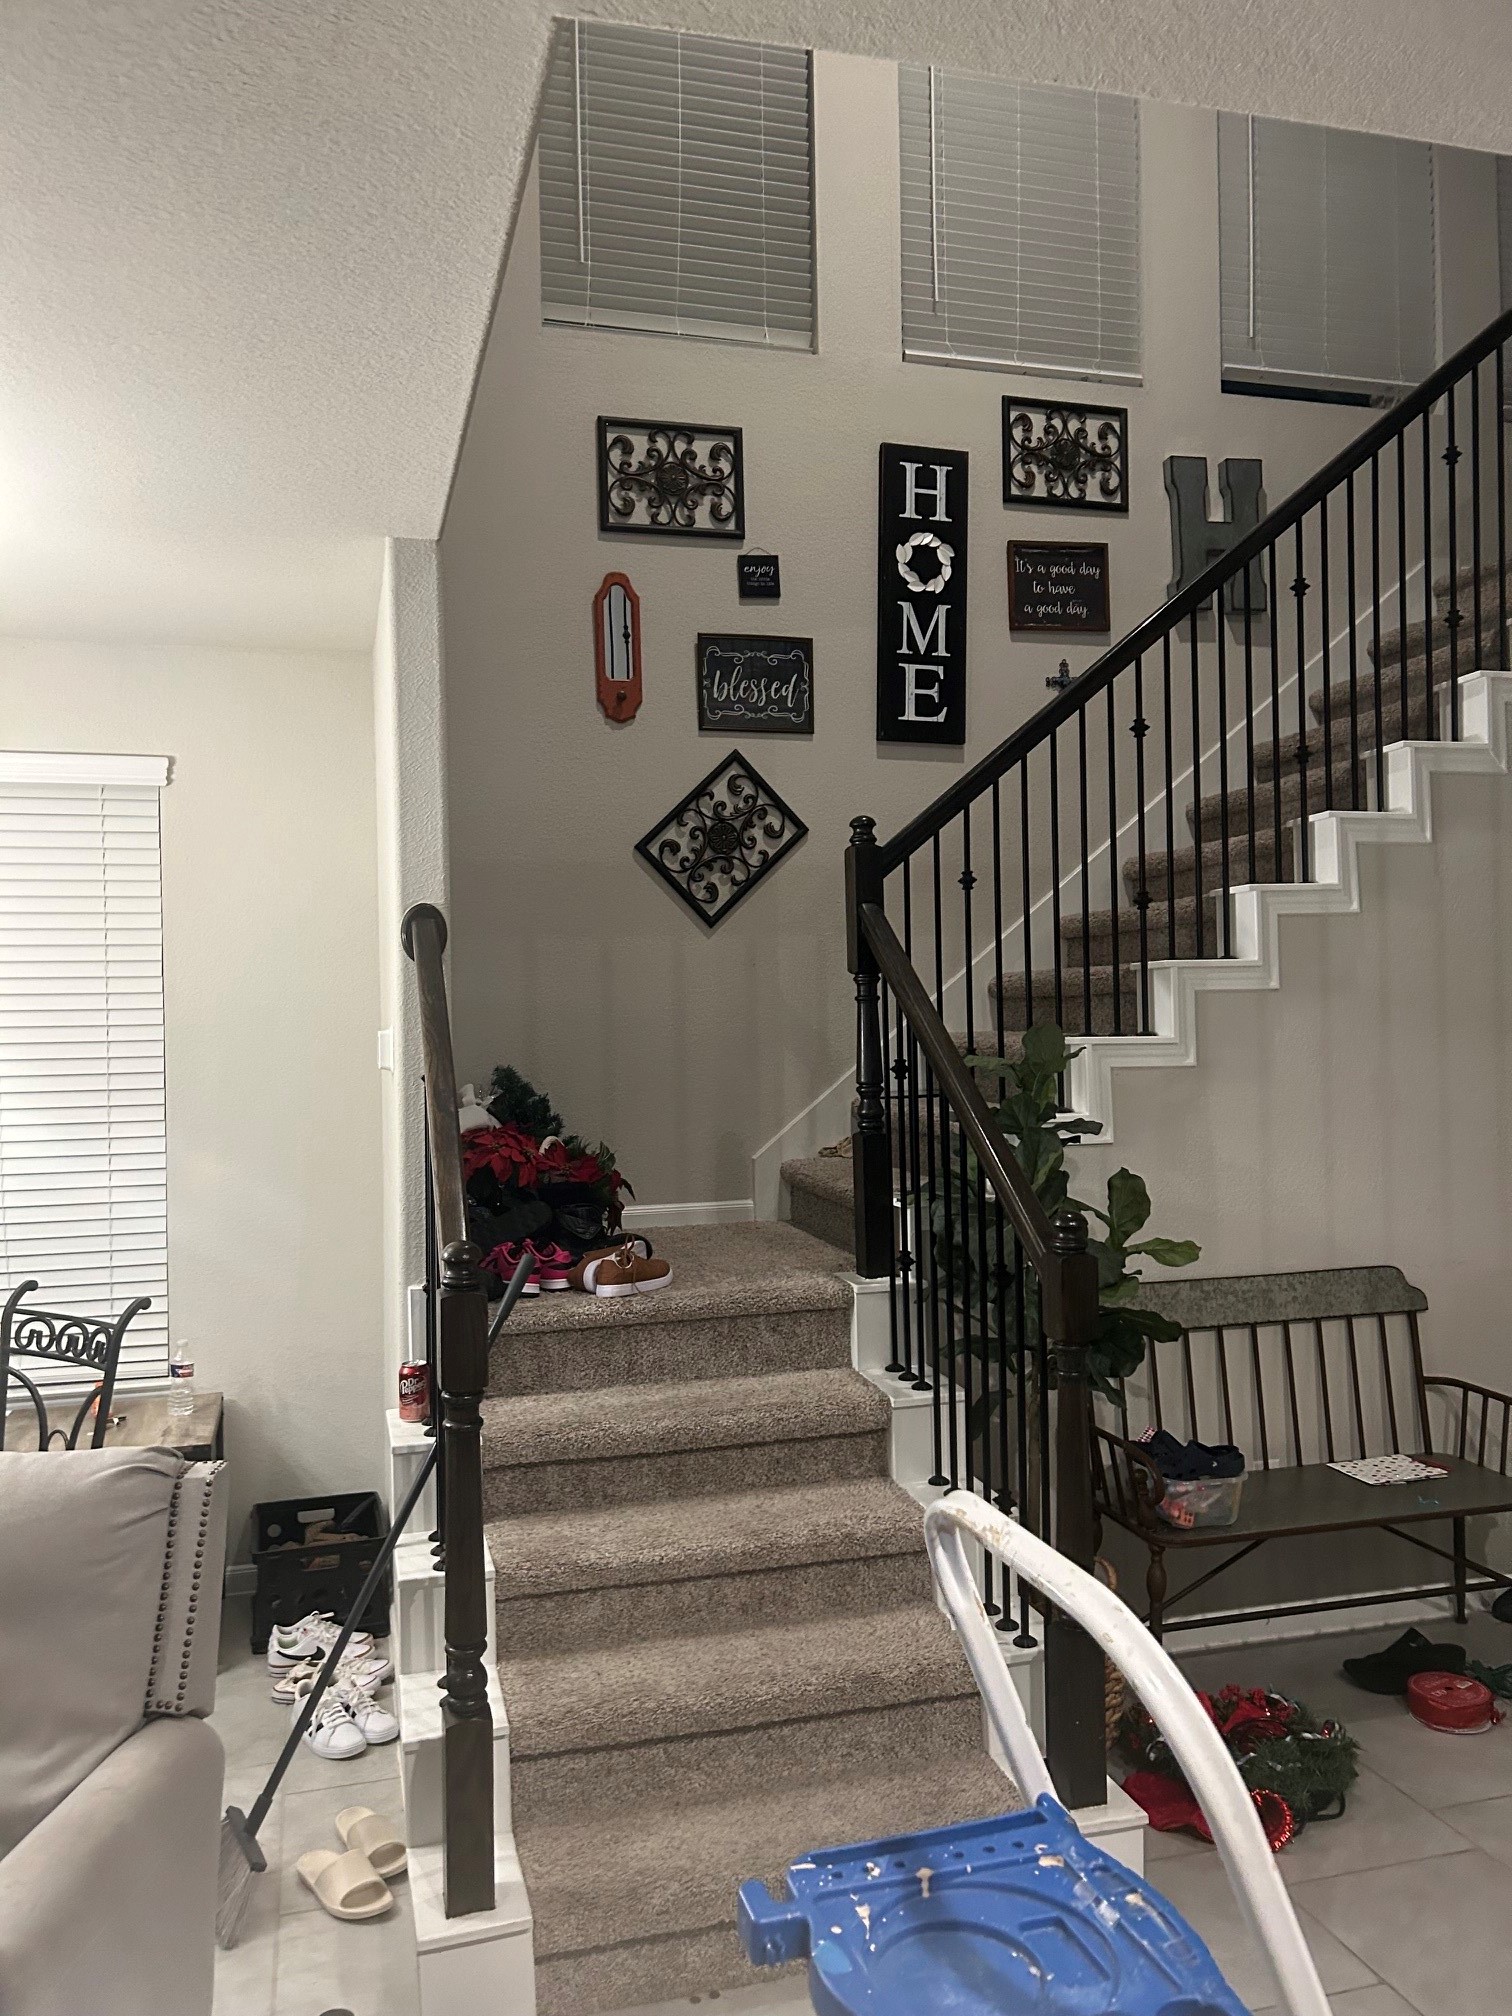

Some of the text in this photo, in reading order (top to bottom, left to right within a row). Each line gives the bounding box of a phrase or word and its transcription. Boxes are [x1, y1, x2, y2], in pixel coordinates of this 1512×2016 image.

[743, 565, 775, 578] enjoy
[1014, 555, 1101, 579] It's a good day
[896, 462, 955, 723] HOME
[1033, 580, 1076, 595] to have
[1024, 604, 1033, 614] a
[1036, 601, 1063, 618] good
[713, 665, 800, 708] blessed
[407, 1378, 419, 1386] Dr
